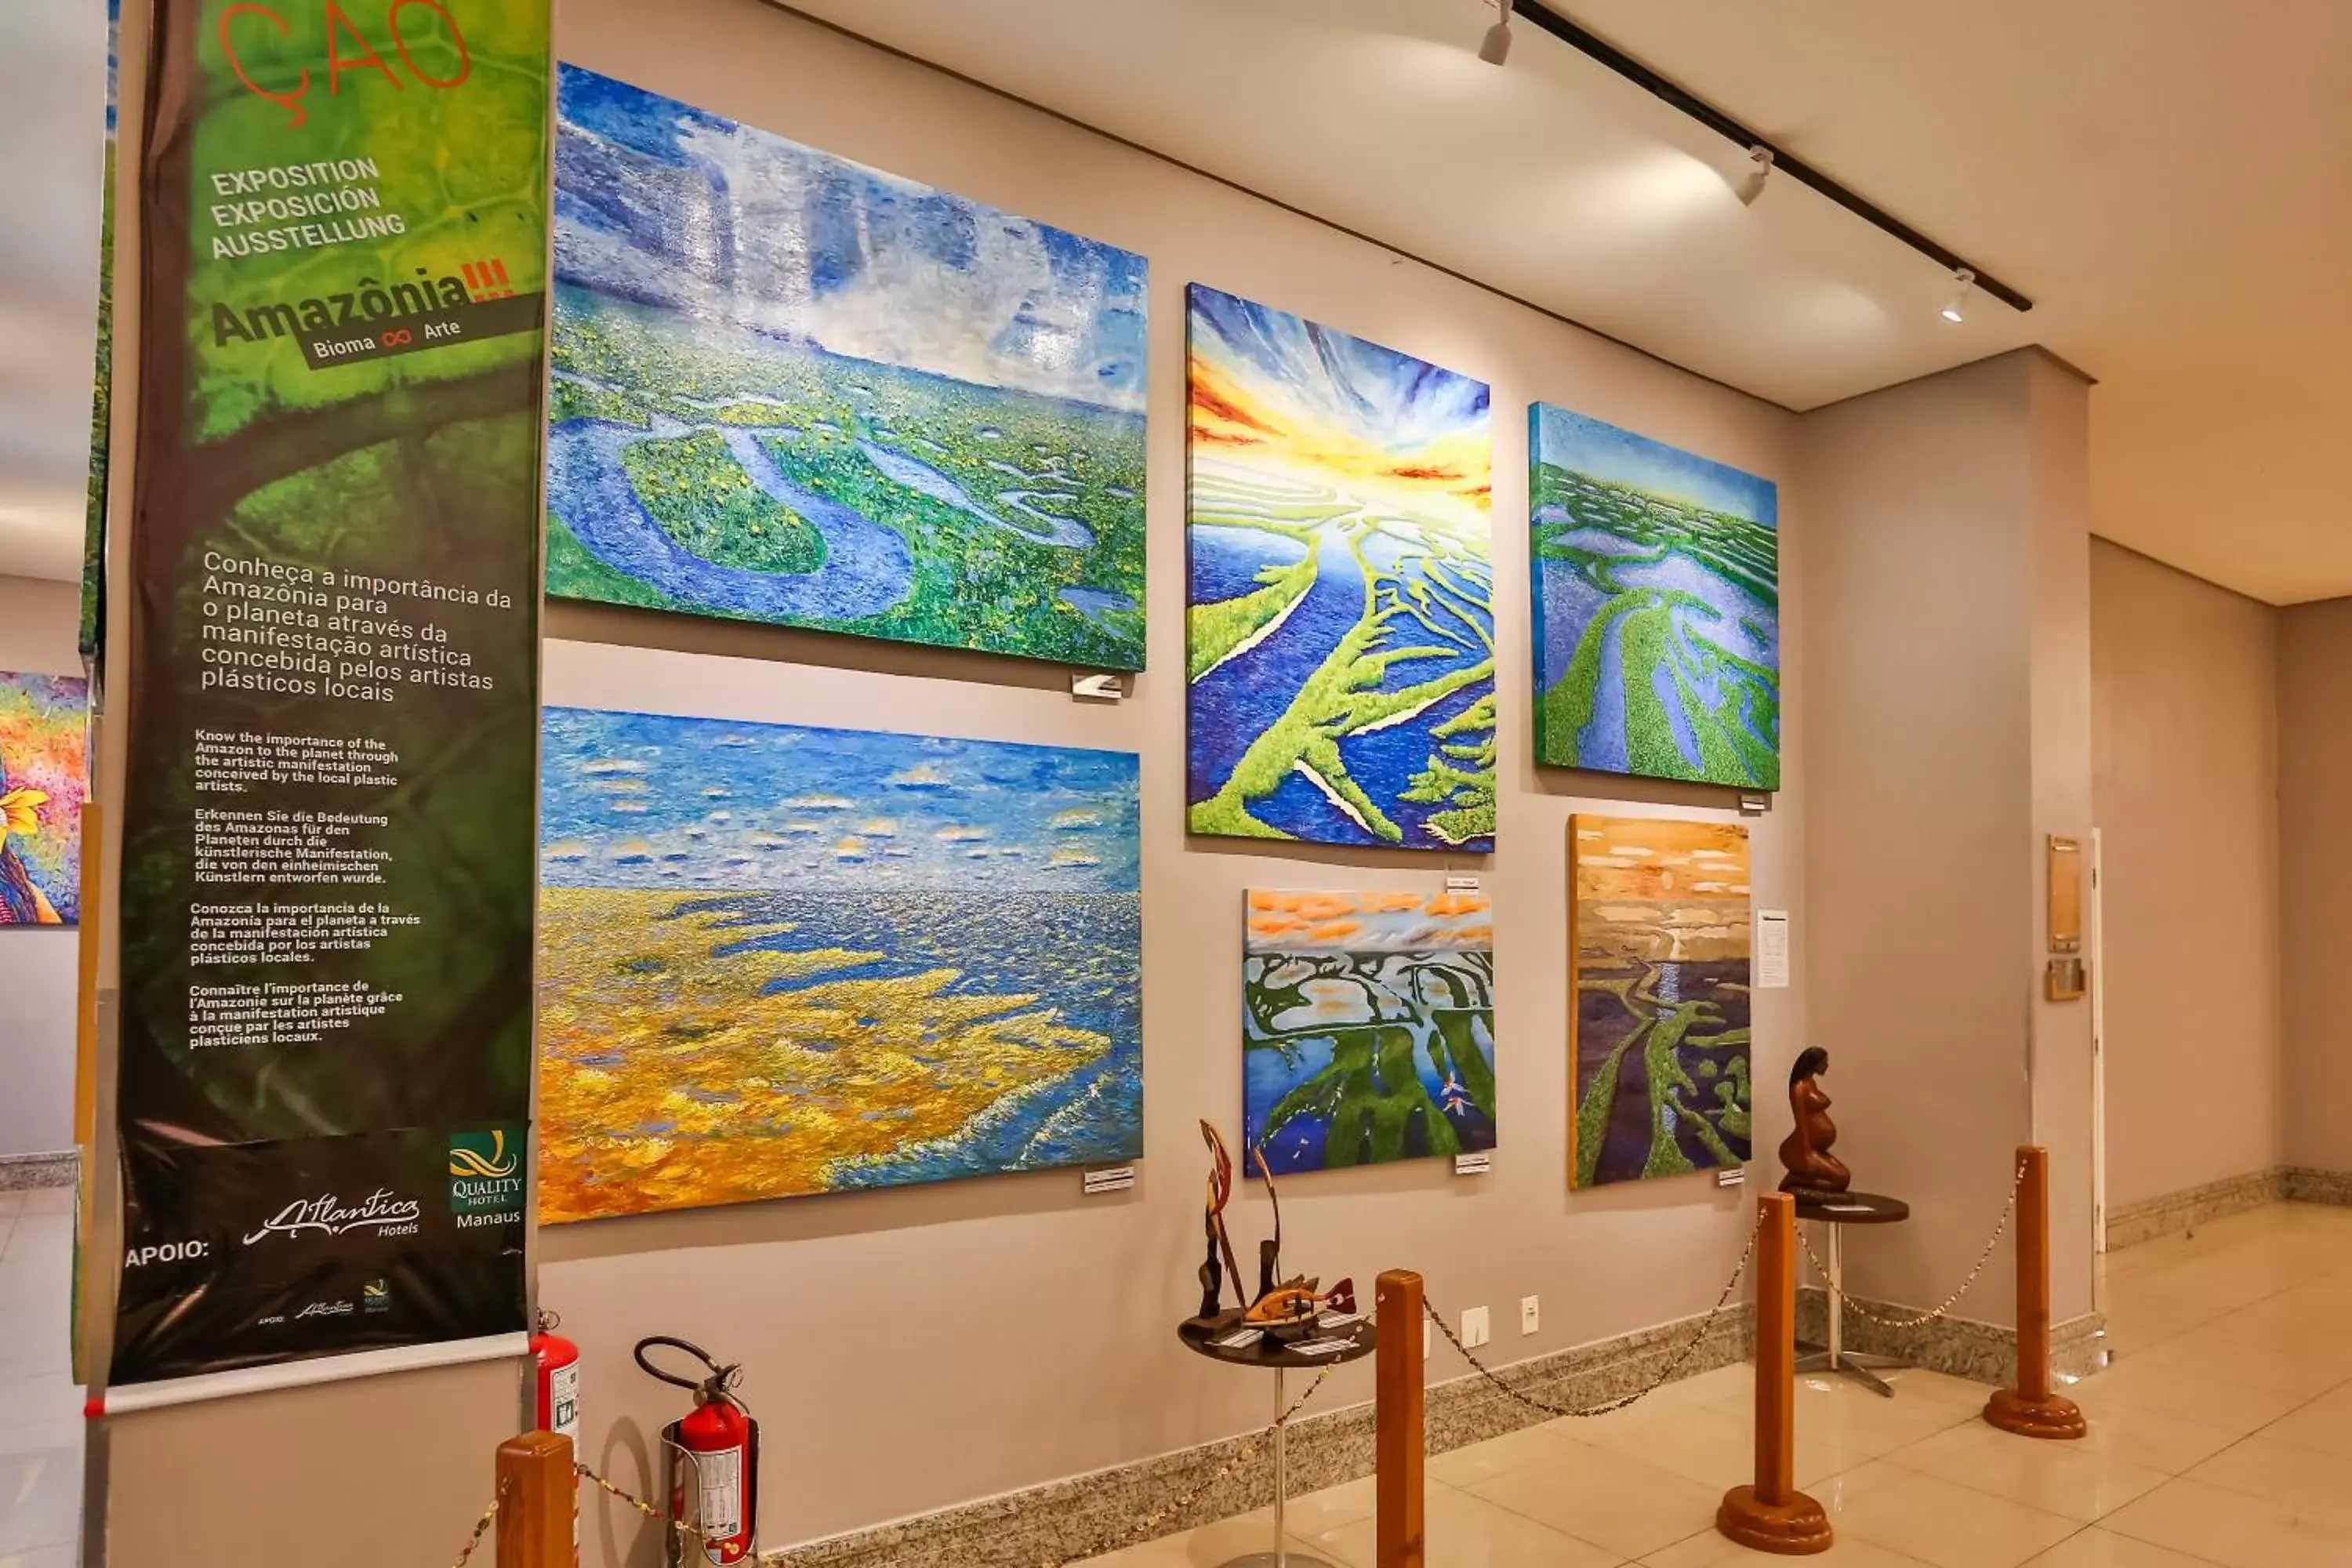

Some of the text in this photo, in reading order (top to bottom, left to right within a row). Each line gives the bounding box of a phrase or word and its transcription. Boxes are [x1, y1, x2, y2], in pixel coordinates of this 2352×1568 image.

[210, 157, 379, 197] EXPOSITION
[210, 186, 380, 227] EXPOSICIÓN
[212, 213, 405, 260] AUSSTELLUNG
[313, 320, 461, 359] Bioma Arte
[204, 551, 511, 608] Conheça a importância da
[202, 575, 387, 614] Amazônia para
[203, 601, 447, 642] o planeta através da
[203, 623, 471, 666] manifestação artística
[202, 647, 493, 690] concebida pelos artistas
[202, 668, 394, 702] plásticos locais
[195, 729, 386, 750] Know the importance of the
[195, 742, 398, 764] Amazon to the planet through
[195, 754, 371, 772] the artistic manifestation
[195, 768, 397, 786] conceived by the local plastic
[195, 779, 248, 792] artists.
[195, 808, 388, 826] Erkennen Sie die Bedeutung
[195, 820, 350, 835] des Amazonas für den
[195, 833, 327, 847] Planeten durch die
[195, 846, 292, 858] künstlerische
[195, 858, 217, 869] die
[252, 859, 277, 870] den
[281, 858, 379, 871] einheimischen
[195, 871, 386, 884] Künstlern entworfen wurde.
[191, 902, 390, 916] Conozca la importancia de la
[191, 915, 261, 927] Amazonía
[267, 917, 296, 928] para
[300, 915, 312, 926] el
[316, 914, 365, 928] planeta
[380, 913, 421, 925] través
[191, 927, 209, 939] de
[212, 927, 226, 938] la
[230, 926, 329, 939] manifestación
[191, 938, 371, 953] concebida por los artistas
[191, 951, 314, 966] plásticos locales.
[353, 980, 368, 992] de
[190, 992, 402, 1008] l'Amazonie sur la planète grâce
[203, 1010, 216, 1022] la
[220, 1007, 318, 1020] manifestation
[321, 1004, 386, 1017] artistique
[189, 1018, 350, 1036] conçue par les artistes
[189, 1031, 322, 1050] plasticiens locaux.
[453, 1179, 521, 1199] QUALITY
[468, 1195, 507, 1206] HOTEL
[242, 1188, 419, 1246] Atlantica
[457, 1211, 521, 1229] Manaus
[378, 1222, 418, 1237] Hotels
[125, 1239, 209, 1268] APOIO:
